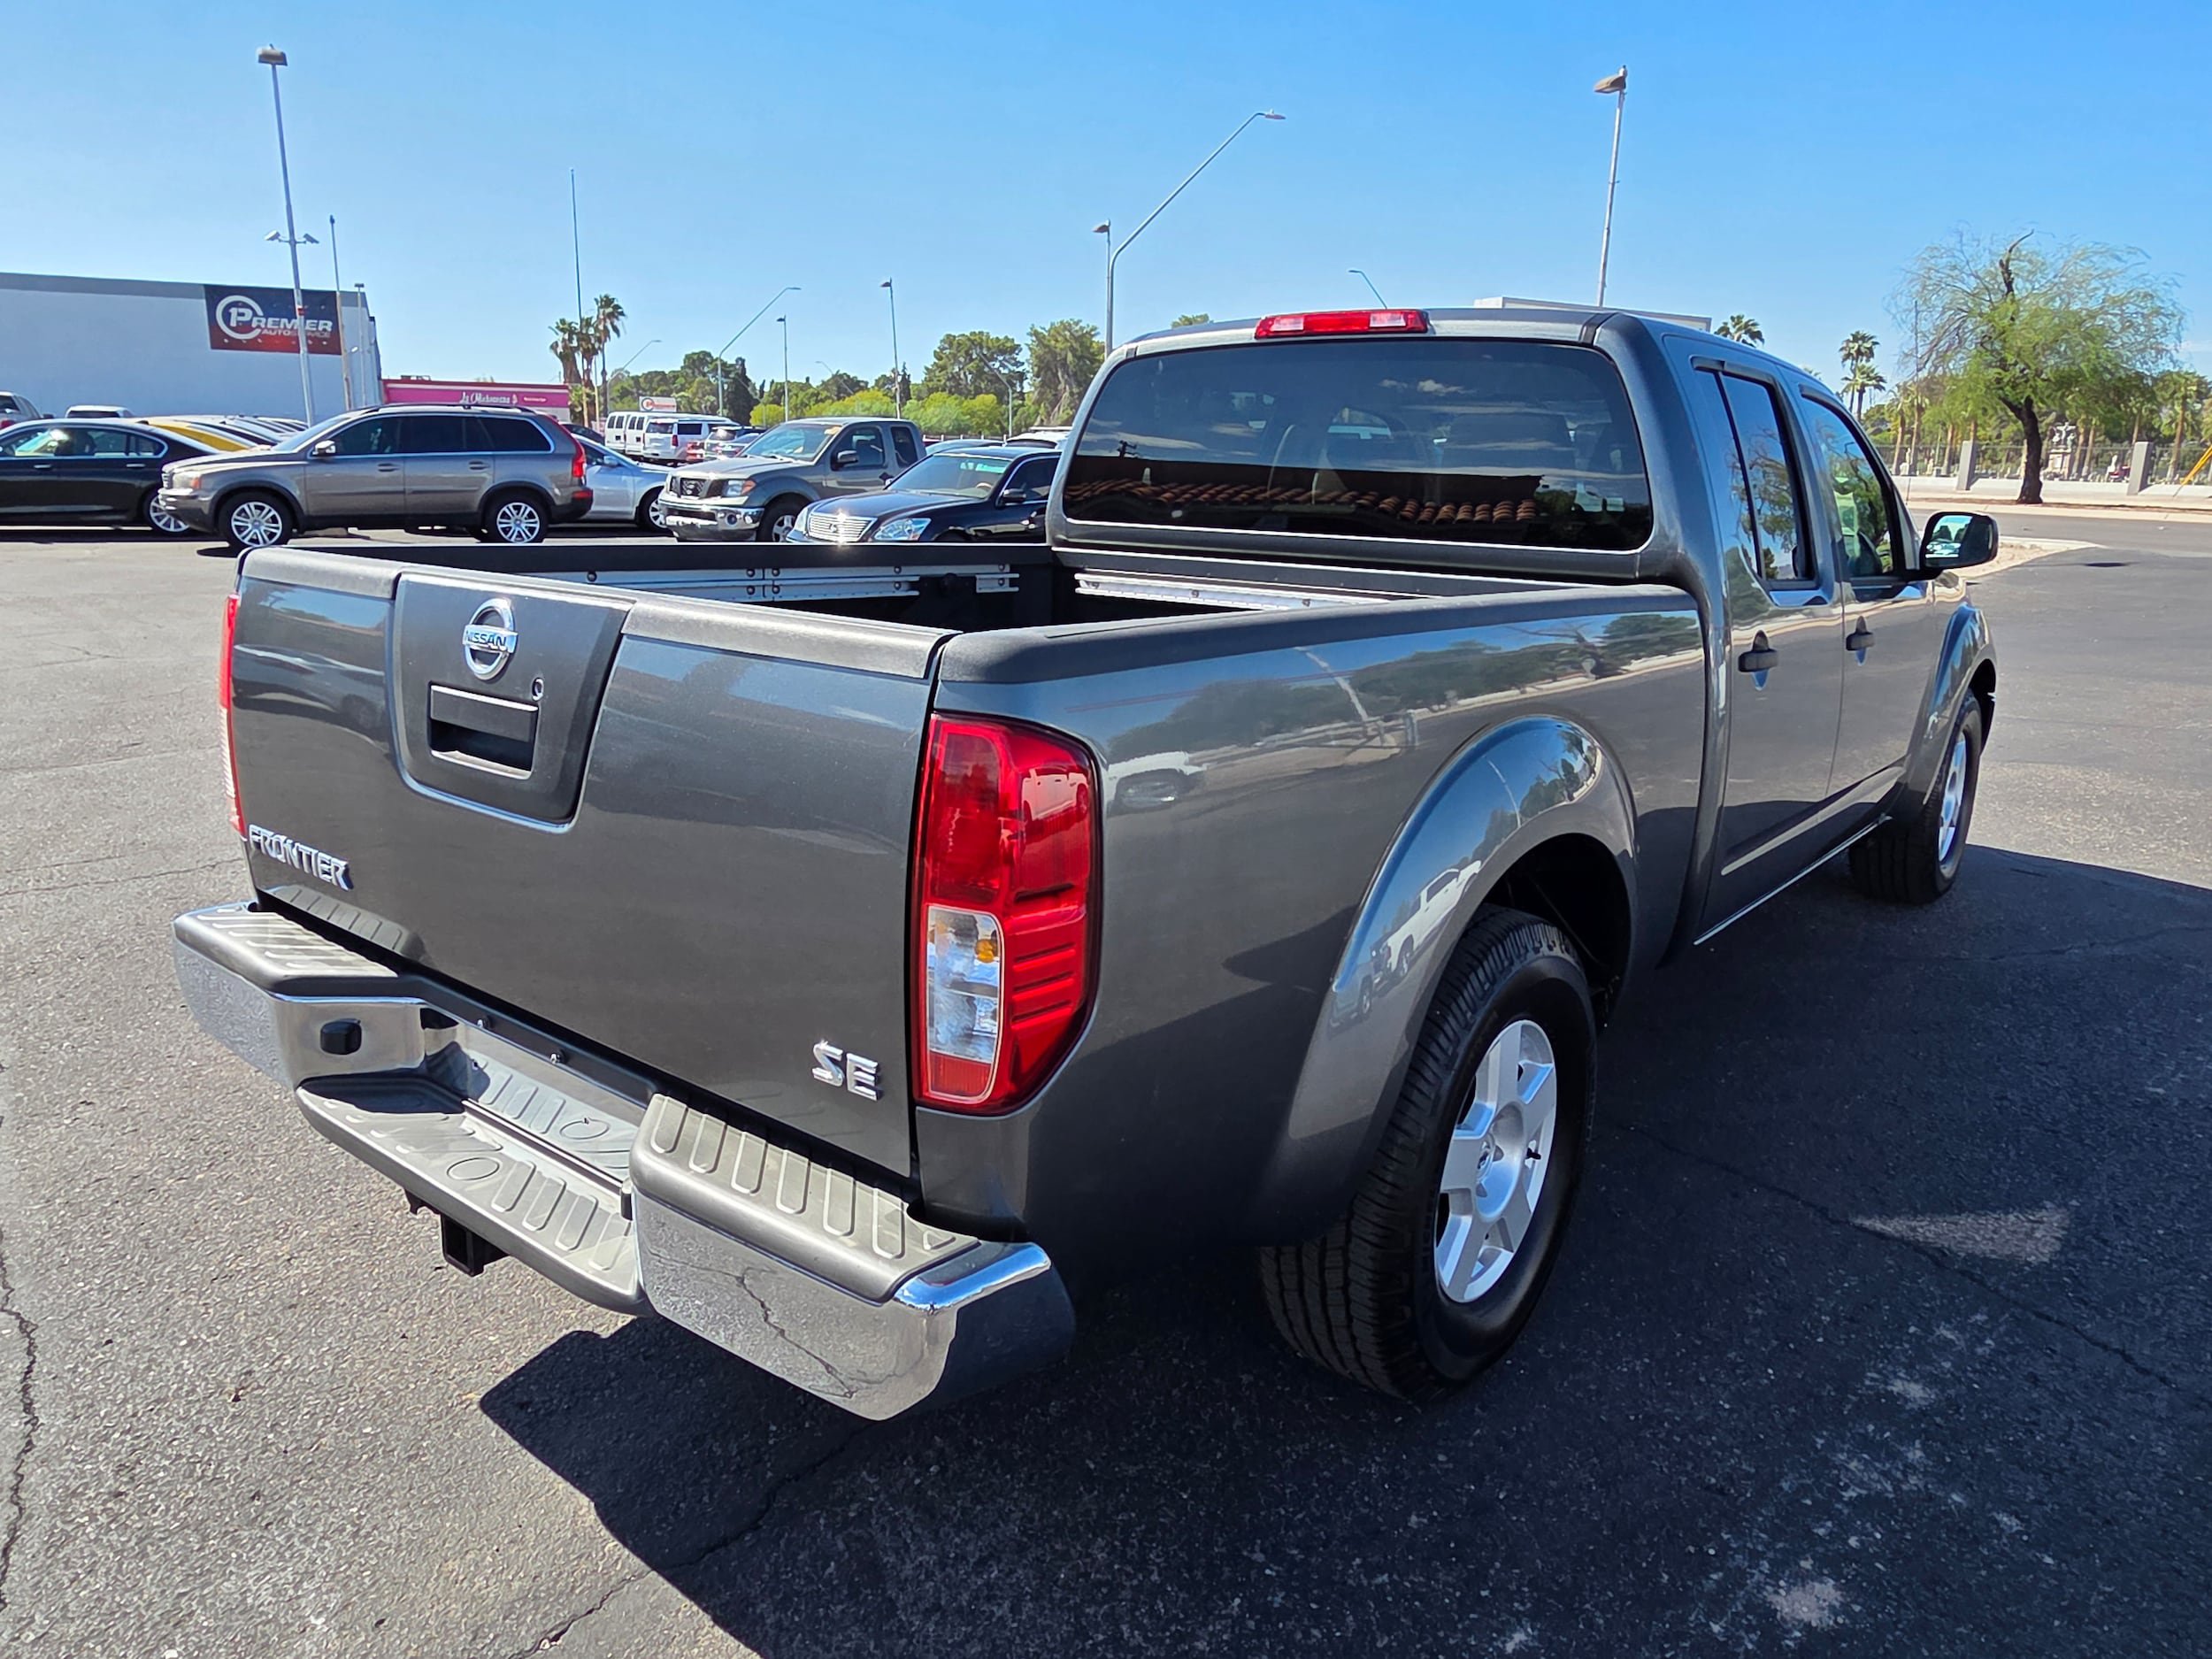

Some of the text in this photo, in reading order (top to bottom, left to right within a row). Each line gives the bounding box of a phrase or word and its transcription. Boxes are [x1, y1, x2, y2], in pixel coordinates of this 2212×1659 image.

[228, 307, 333, 332] PREMER
[465, 630, 508, 647] NISSAN
[249, 824, 350, 891] FRONTIER
[812, 1041, 879, 1102] SE
